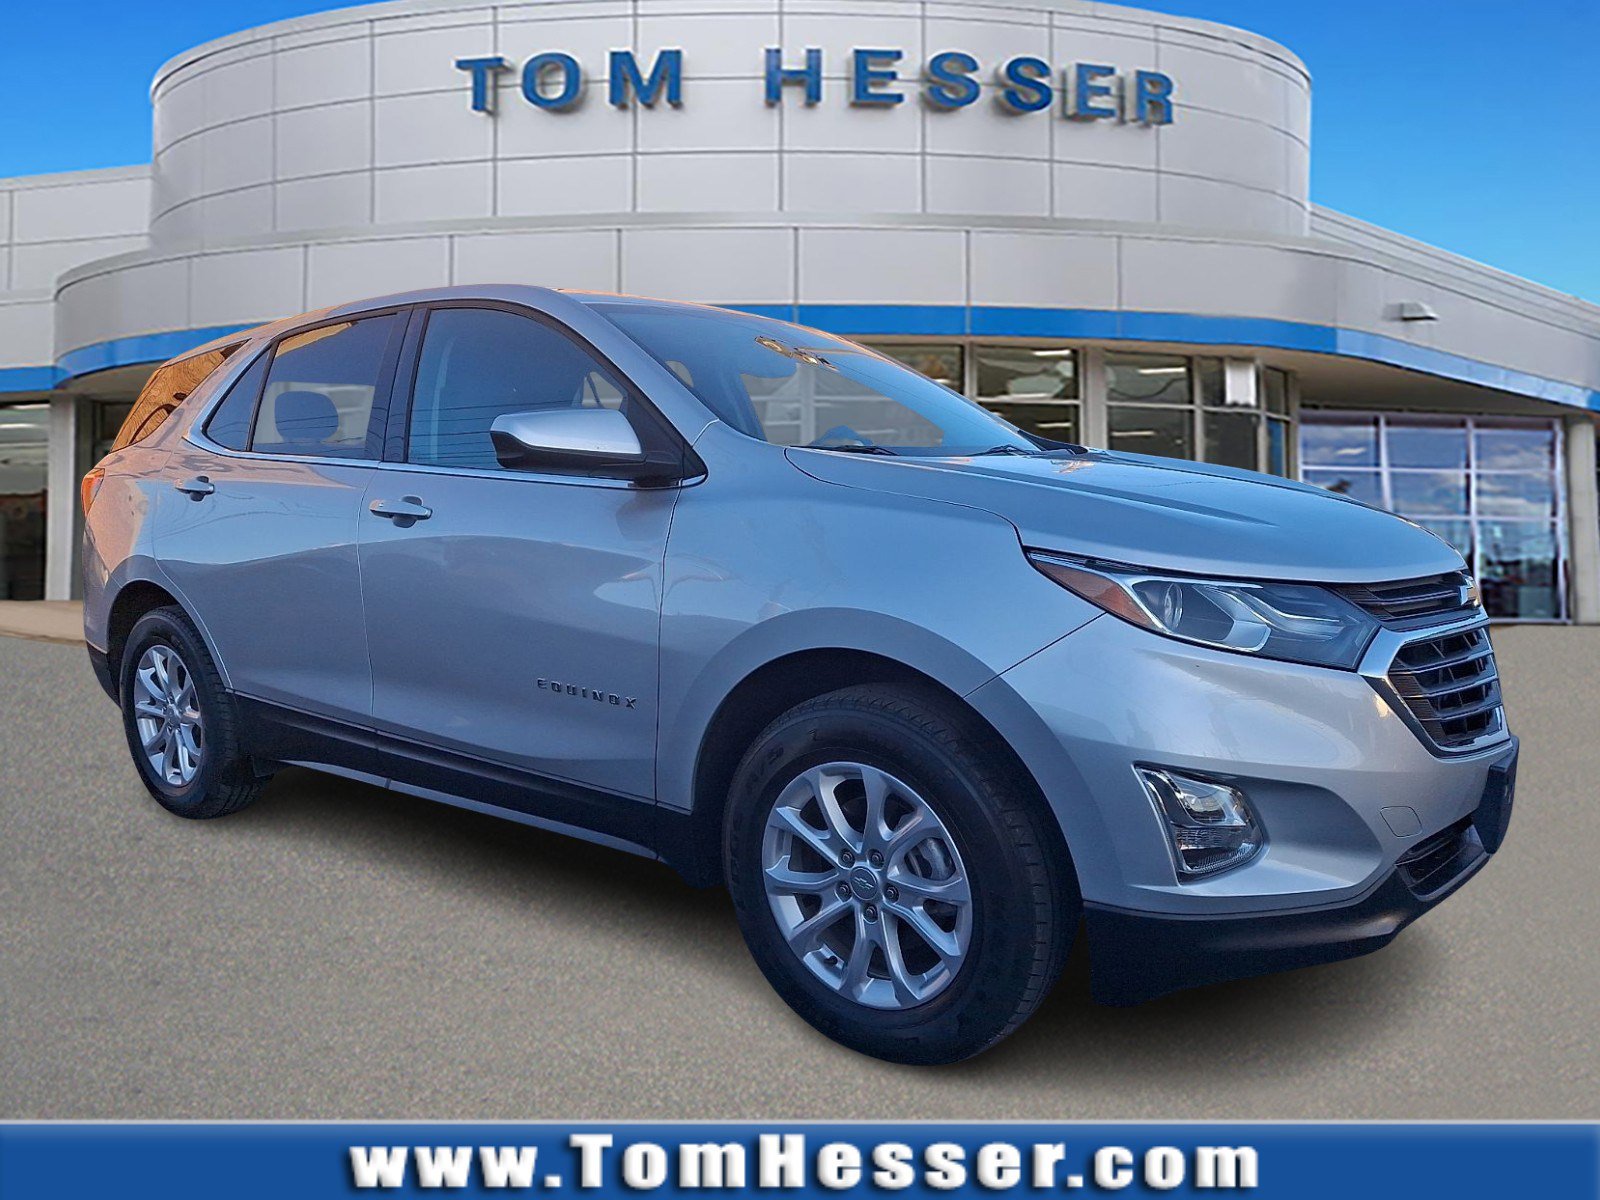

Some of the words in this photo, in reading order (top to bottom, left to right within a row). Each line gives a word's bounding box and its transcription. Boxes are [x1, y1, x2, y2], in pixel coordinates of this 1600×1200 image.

[455, 49, 682, 112] TOM
[765, 48, 1176, 126] HESSER
[537, 677, 637, 709] EQUINOX
